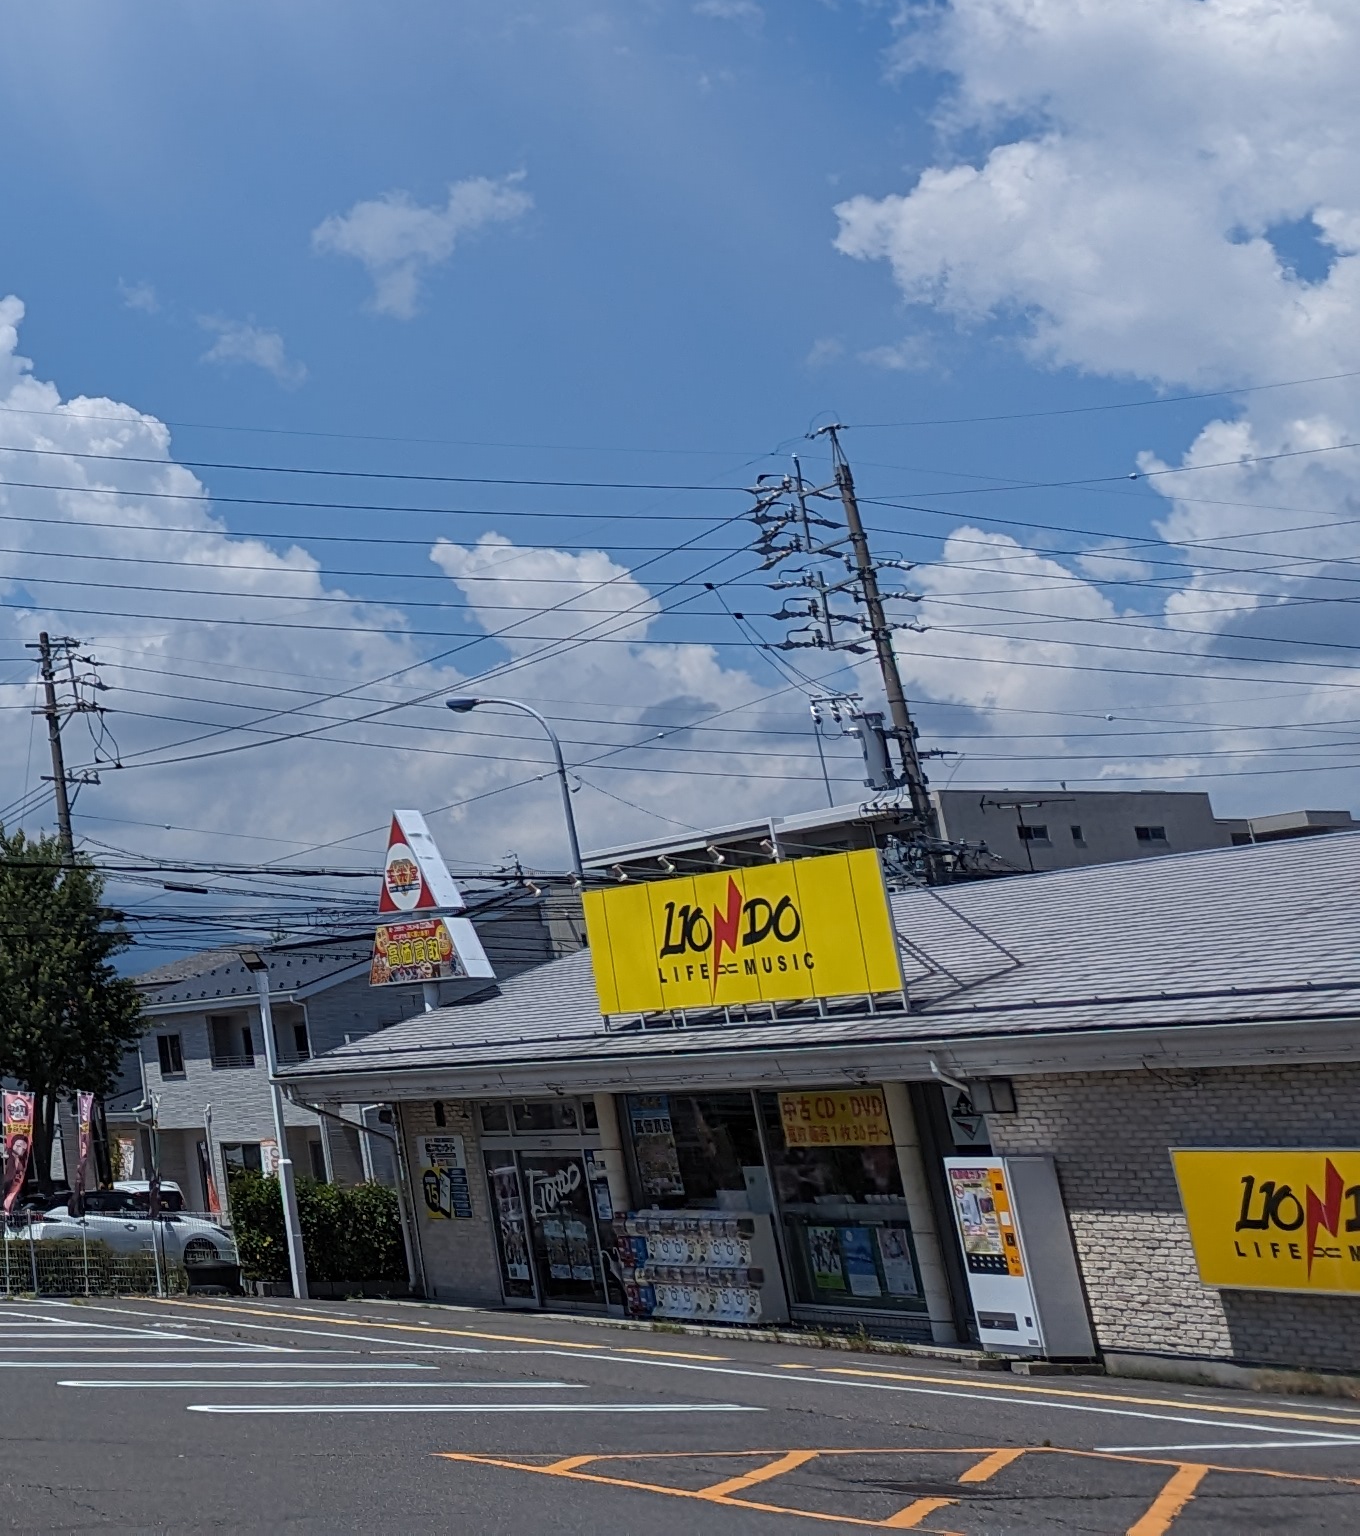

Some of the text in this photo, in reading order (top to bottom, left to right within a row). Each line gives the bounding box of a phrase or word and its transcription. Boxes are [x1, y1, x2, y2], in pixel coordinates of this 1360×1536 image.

[659, 875, 801, 989] LIONDO
[386, 937, 441, 967] 高価買取
[658, 952, 815, 984] LIFE MUSIC
[426, 1183, 440, 1206] 15
[1234, 1240, 1302, 1260] LIFE
